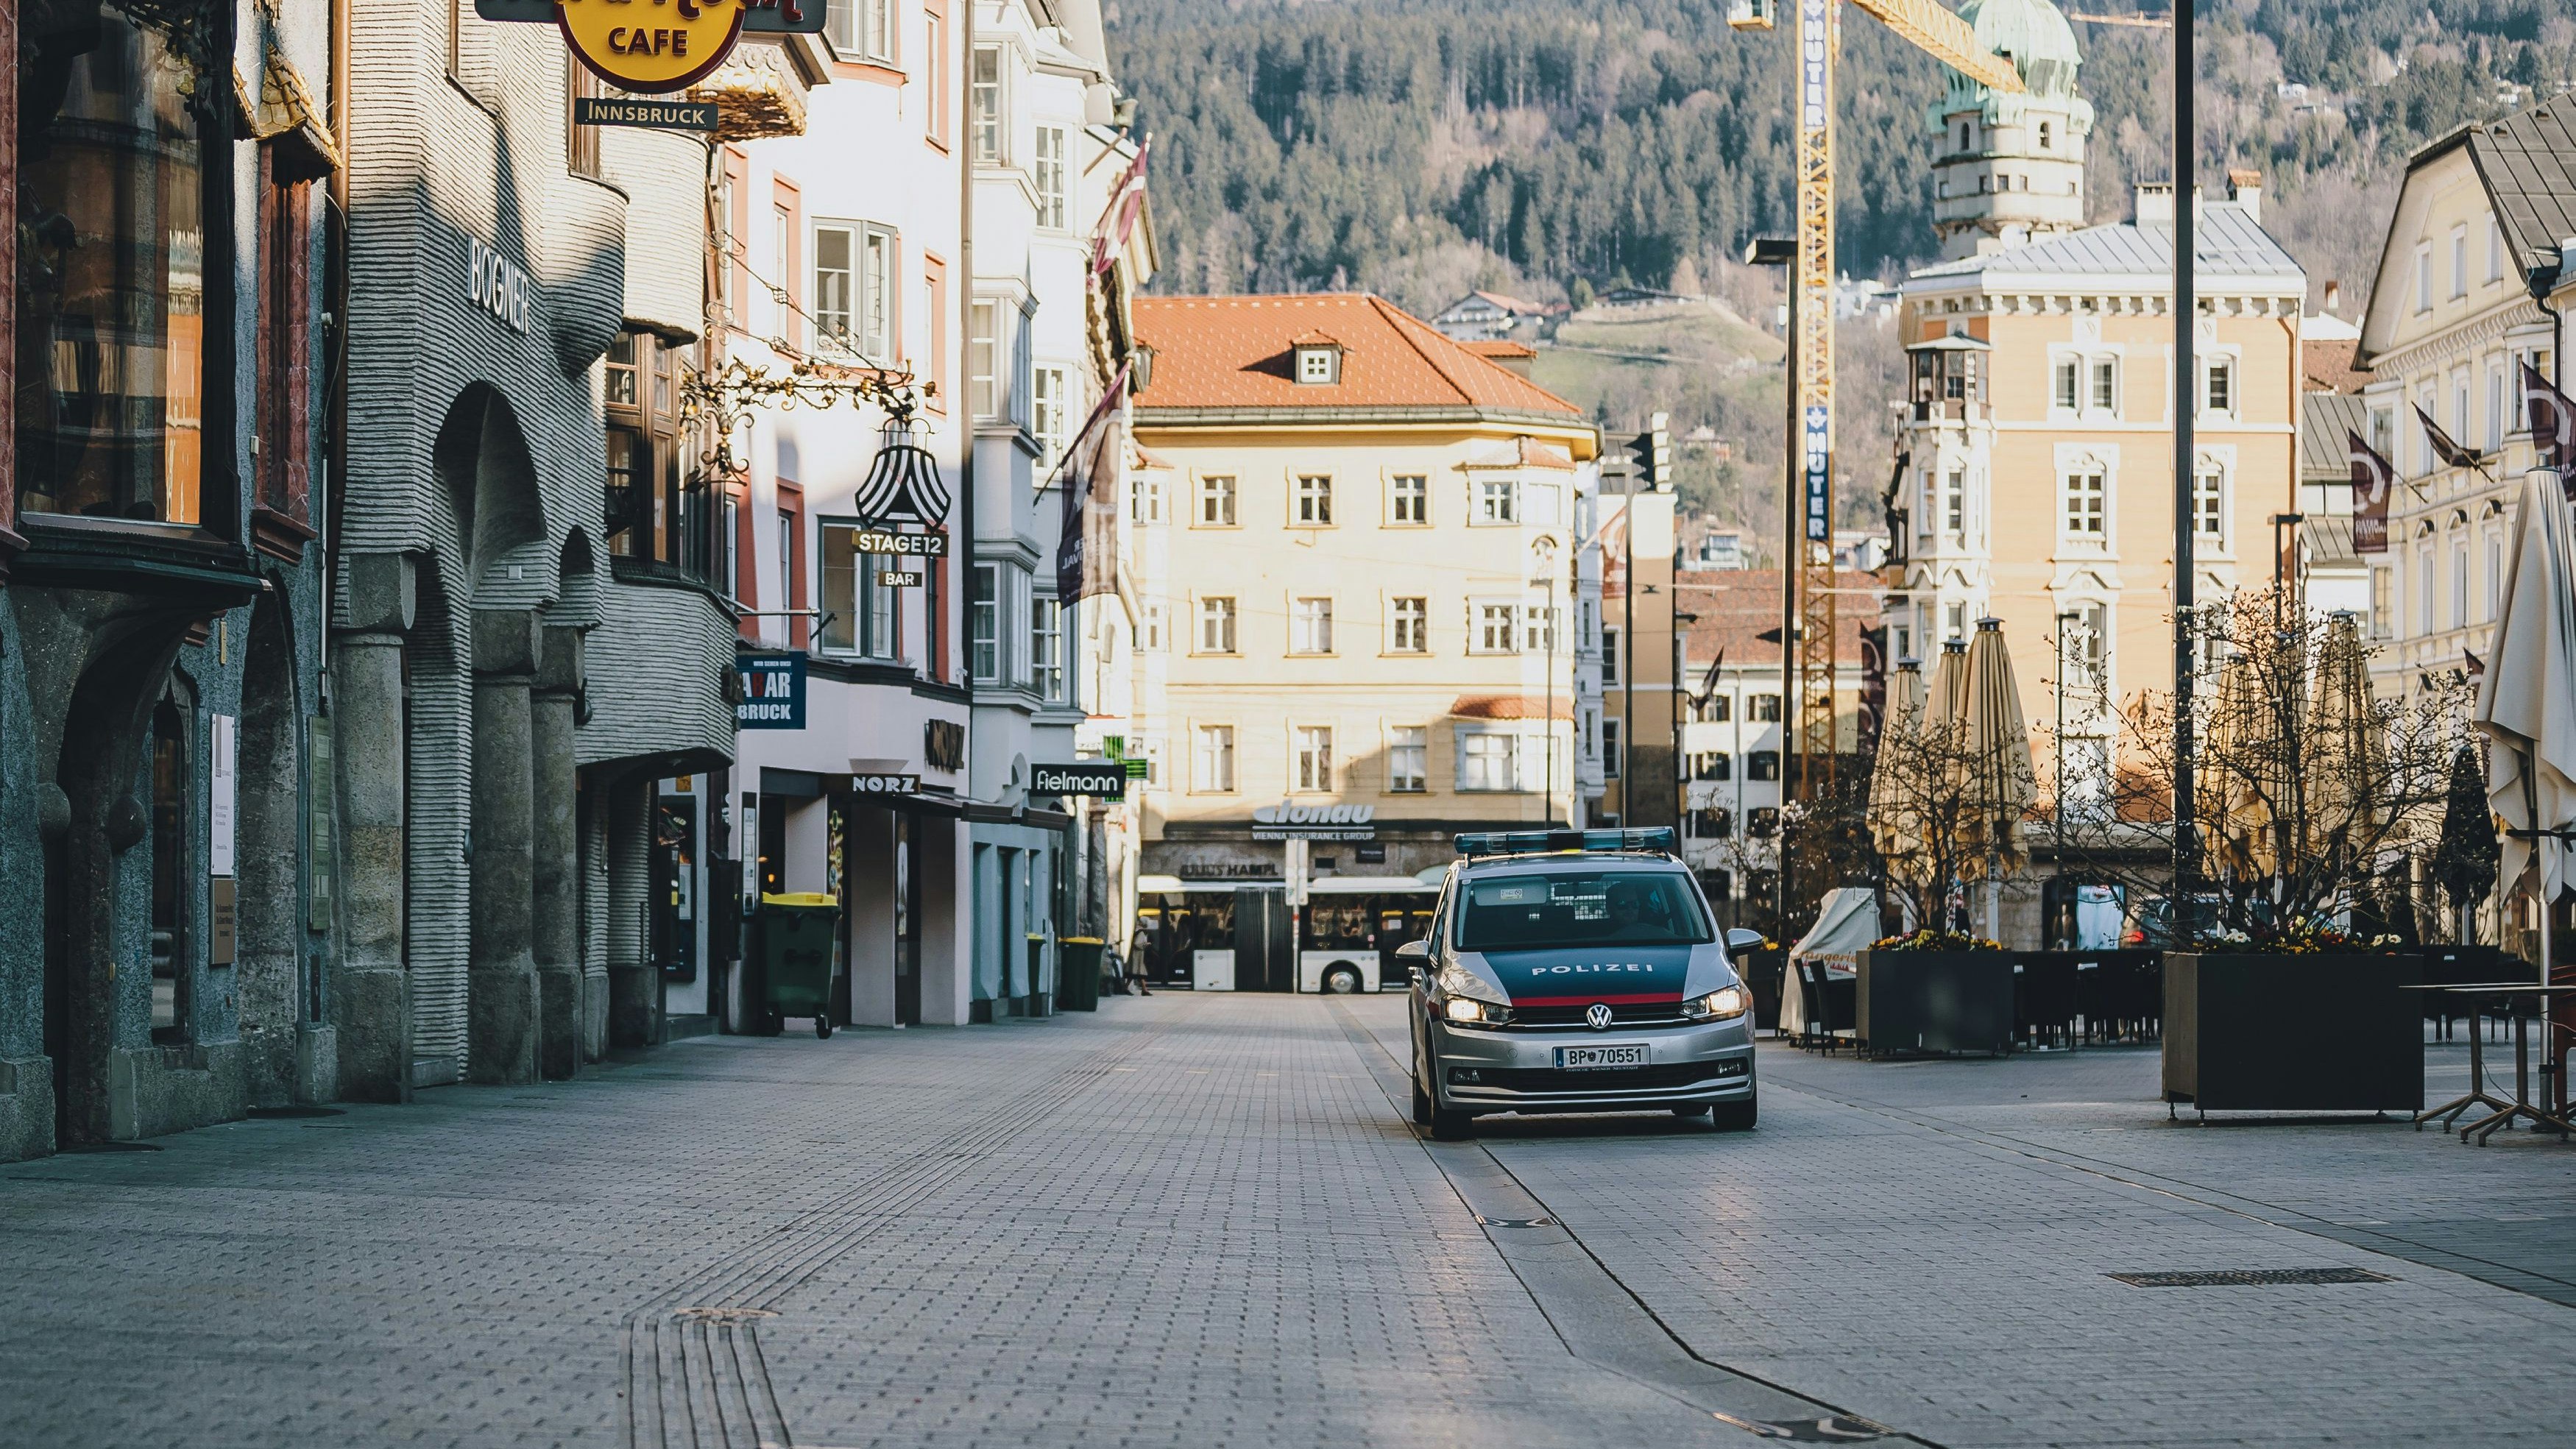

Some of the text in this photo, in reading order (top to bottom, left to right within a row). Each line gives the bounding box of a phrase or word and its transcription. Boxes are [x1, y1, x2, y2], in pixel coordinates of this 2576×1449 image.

[607, 27, 689, 54] CAFE
[1805, 20, 1824, 126] HUTER
[588, 101, 706, 124] INNSBRUCK
[468, 236, 529, 335] BOGNER
[1807, 432, 1826, 536] HUTER
[859, 534, 941, 553] STAGE12
[885, 573, 914, 586] BAR
[742, 672, 790, 698] ABAR
[737, 704, 791, 720] BRUCK
[852, 776, 915, 793] NORZ
[1253, 799, 1374, 823] donau
[1253, 832, 1375, 840] VIENNA INSURANCE GROUP
[1532, 964, 1653, 976] POLIZEI
[1569, 1050, 1587, 1065] BP
[1599, 1048, 1641, 1064] 70551
